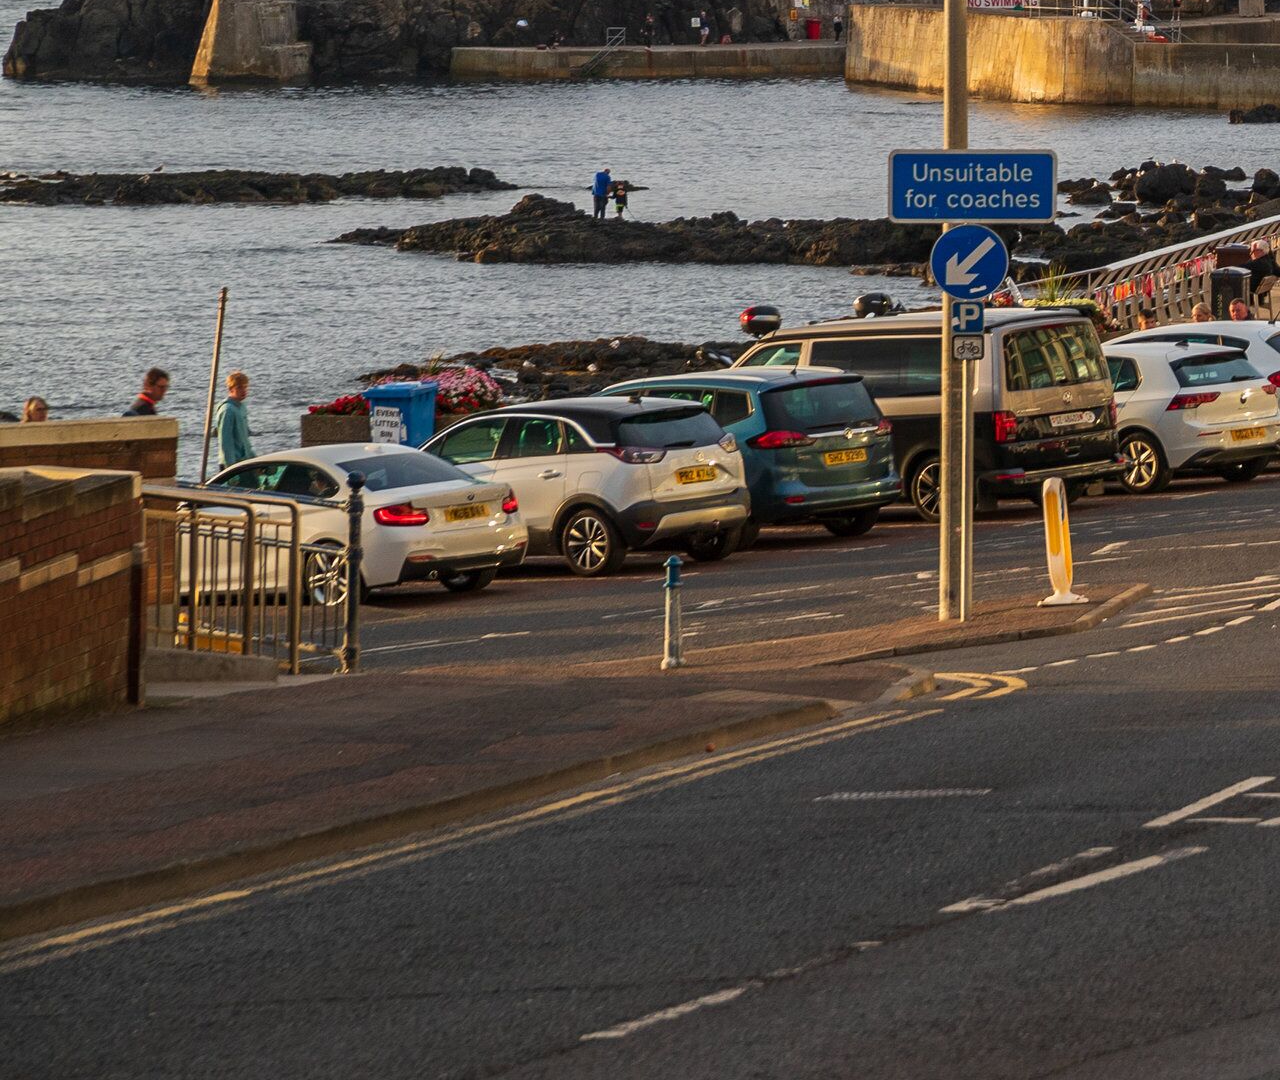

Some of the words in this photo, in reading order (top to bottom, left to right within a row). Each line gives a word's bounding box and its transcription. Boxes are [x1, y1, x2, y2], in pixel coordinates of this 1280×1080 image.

[912, 162, 1033, 182] Unsuitable
[905, 189, 937, 208] for
[947, 188, 1041, 208] coaches
[959, 304, 980, 330] P
[375, 409, 400, 417] EVENT
[375, 420, 399, 428] LITTER
[380, 430, 393, 438] BIN
